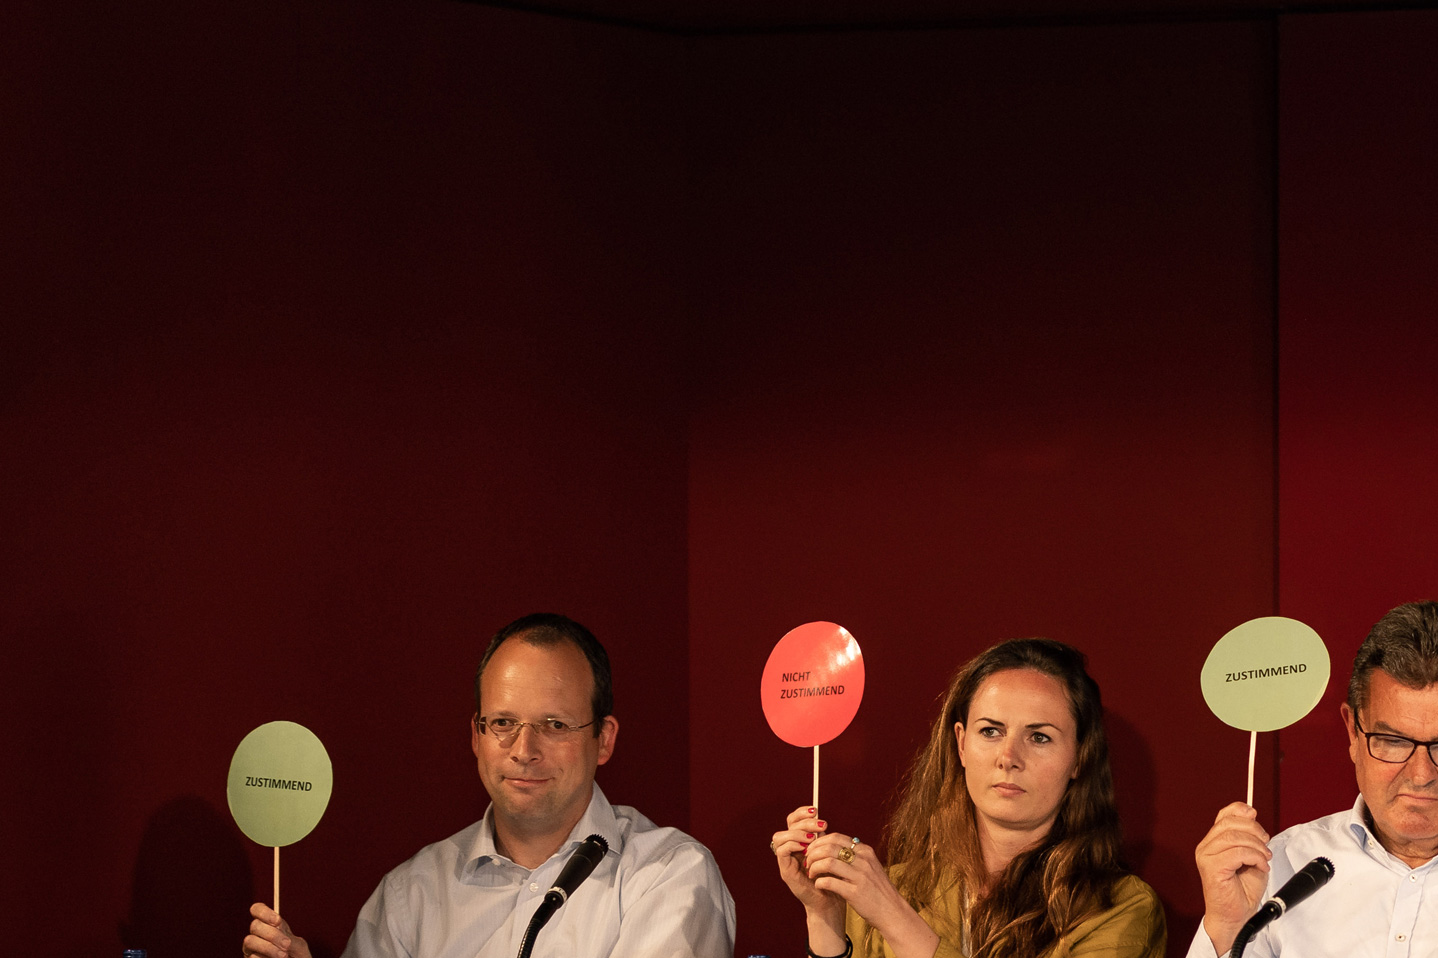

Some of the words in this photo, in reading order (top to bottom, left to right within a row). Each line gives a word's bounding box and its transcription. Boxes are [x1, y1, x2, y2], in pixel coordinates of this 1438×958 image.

[781, 671, 811, 683] NICHT
[1225, 663, 1307, 683] ZUSTIMMEND
[780, 685, 845, 699] ZUSTIMMEND
[245, 776, 312, 792] ZUSTIMMEND
